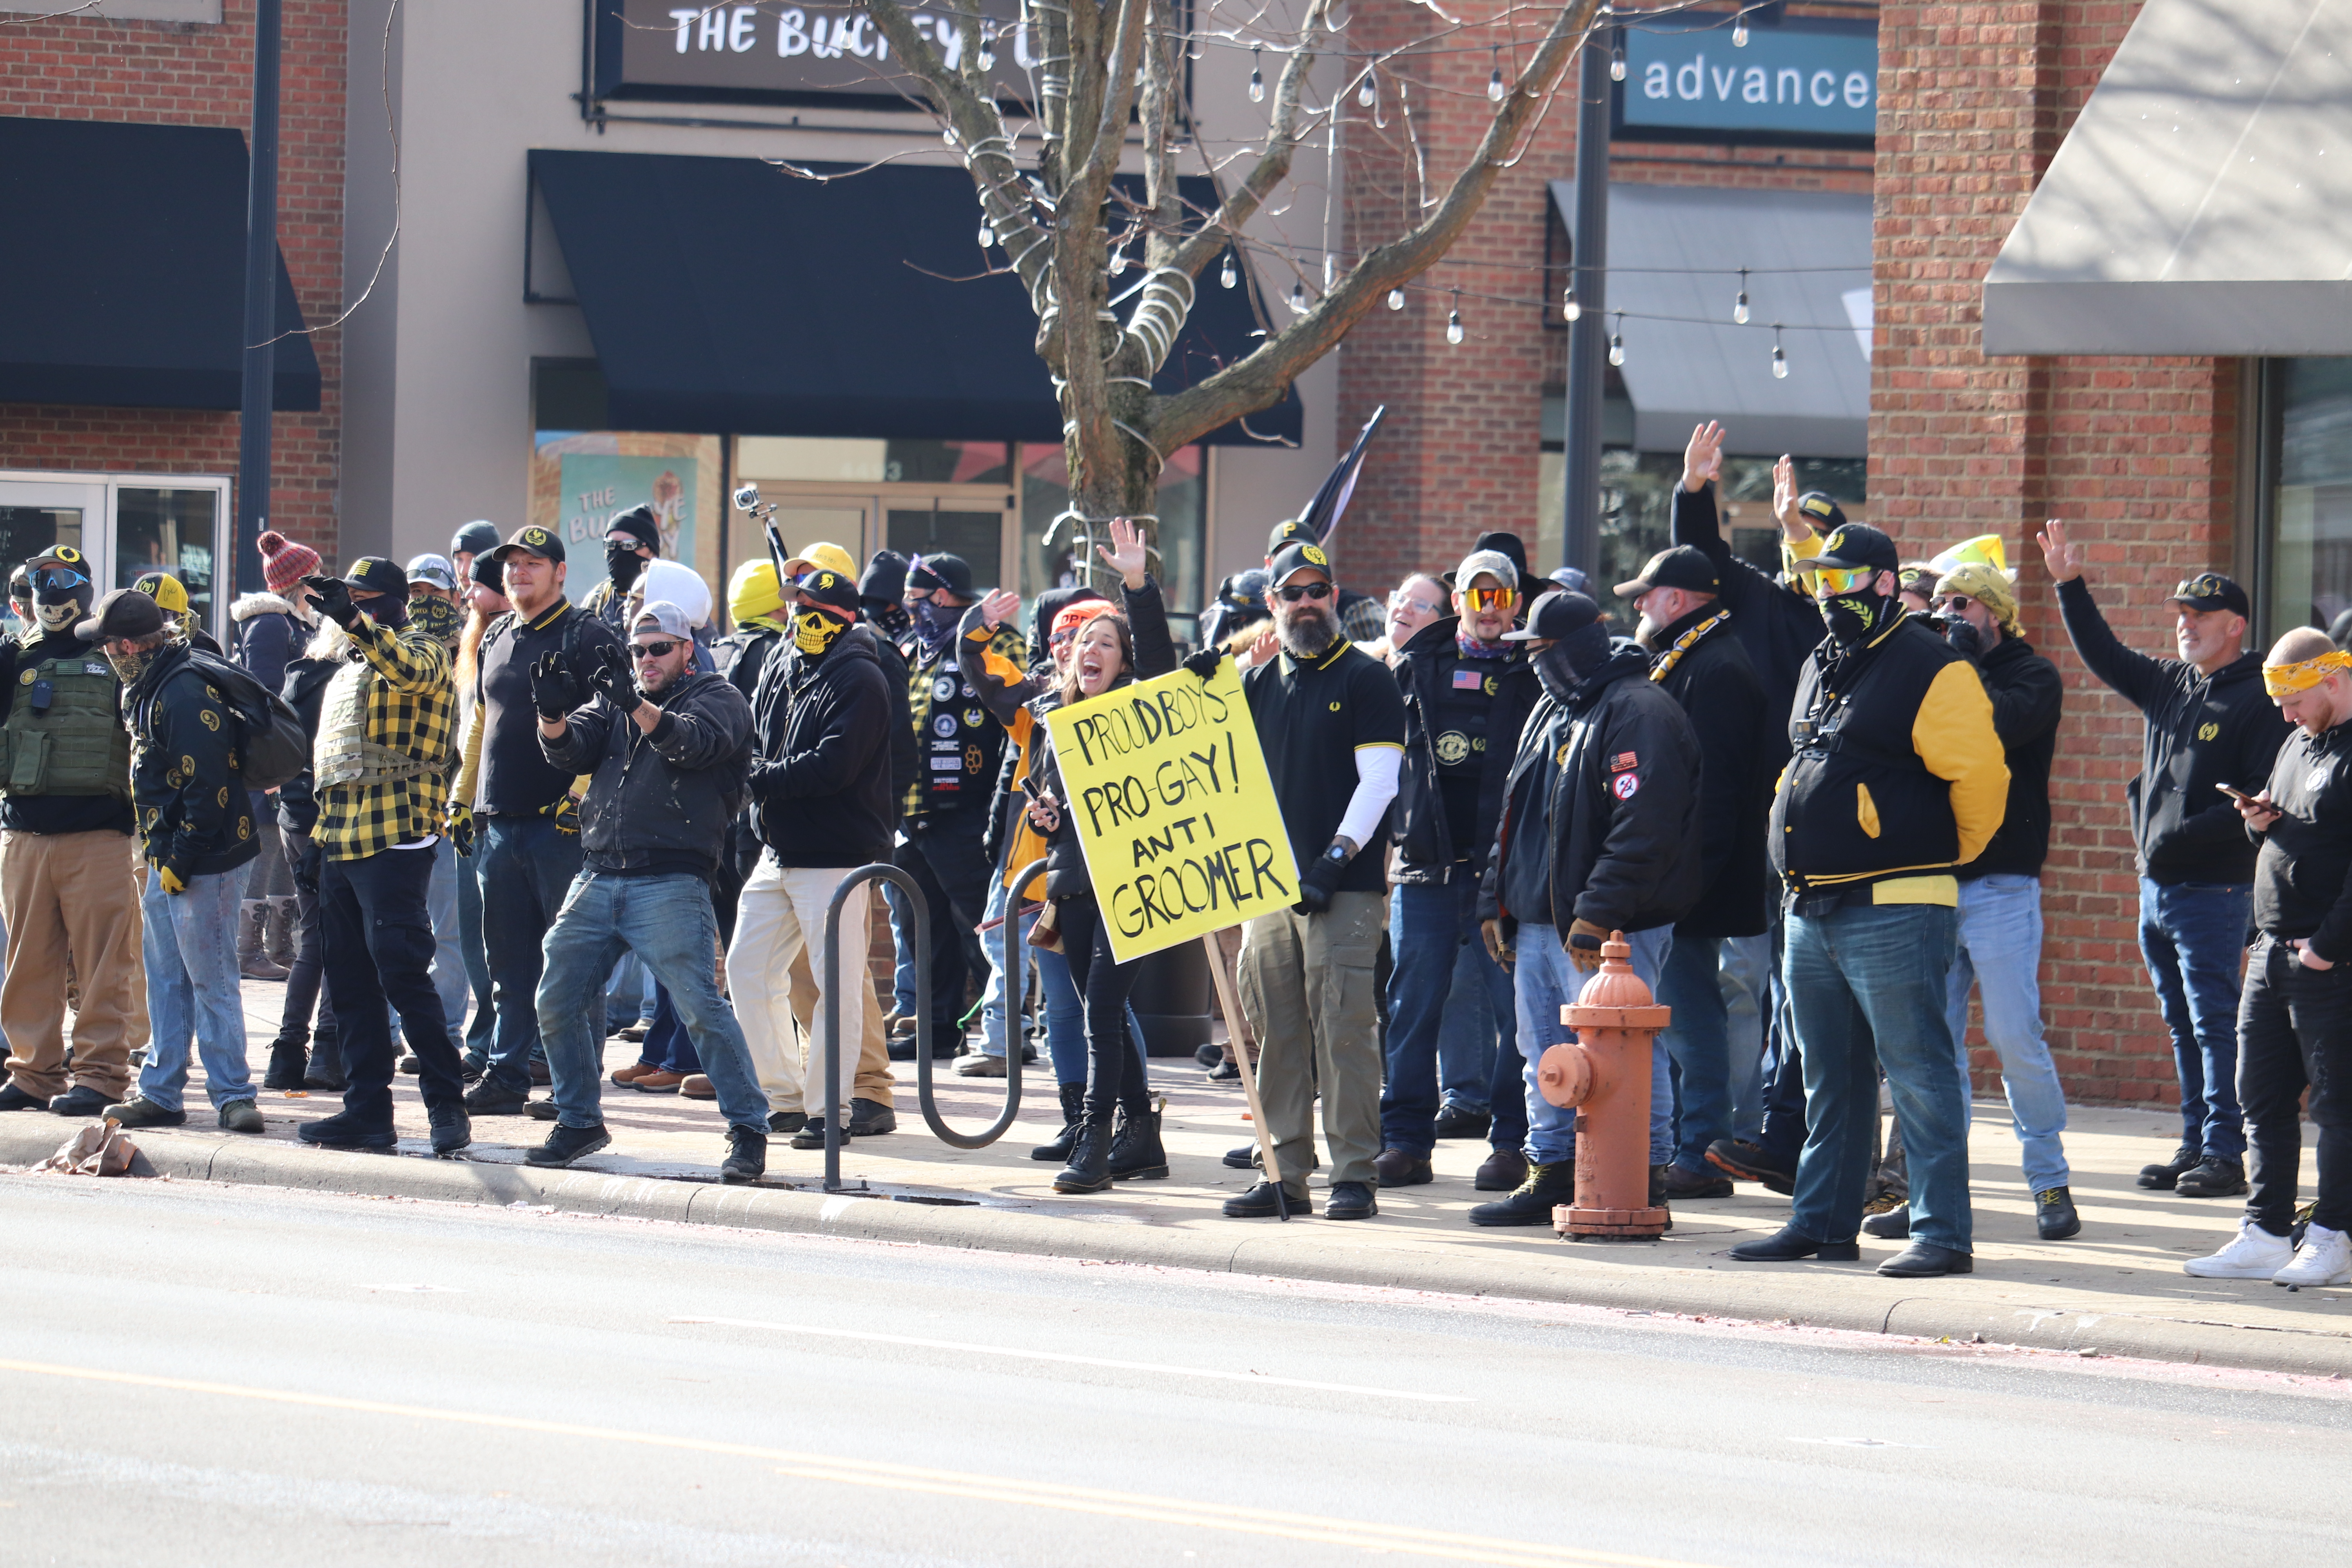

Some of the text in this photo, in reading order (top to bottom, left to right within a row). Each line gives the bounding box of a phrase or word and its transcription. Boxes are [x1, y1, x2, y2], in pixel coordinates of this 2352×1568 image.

[668, 7, 757, 54] THE
[1644, 54, 1870, 109] advance
[579, 487, 616, 512] THE
[1283, 523, 1296, 537] P
[142, 582, 152, 592] PB
[1132, 812, 1216, 868] ANTI
[1112, 838, 1289, 938] GROOMER
